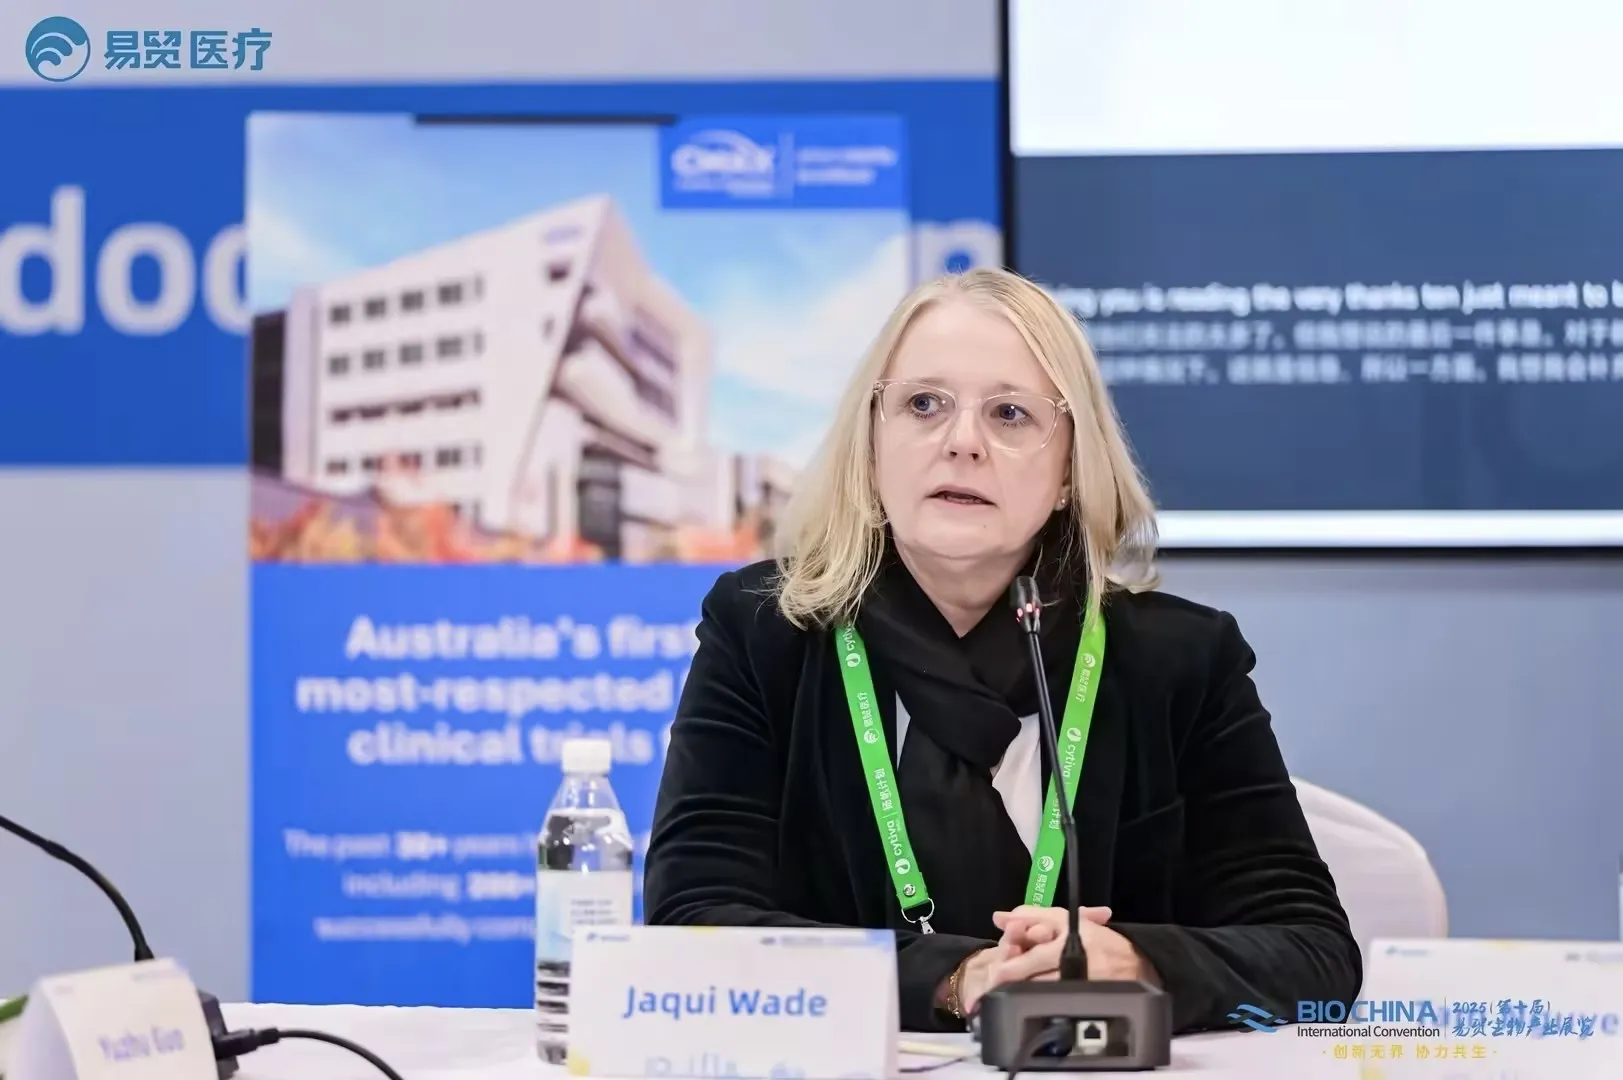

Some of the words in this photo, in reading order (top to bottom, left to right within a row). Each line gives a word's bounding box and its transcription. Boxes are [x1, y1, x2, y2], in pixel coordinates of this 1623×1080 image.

[345, 615, 600, 659] Australia's
[295, 671, 674, 716] most-respected
[346, 721, 523, 765] clinical
[1063, 744, 1077, 778] cytiva
[886, 820, 903, 856] cytiva
[621, 986, 717, 1020] Jaqui
[728, 988, 829, 1018] Wade
